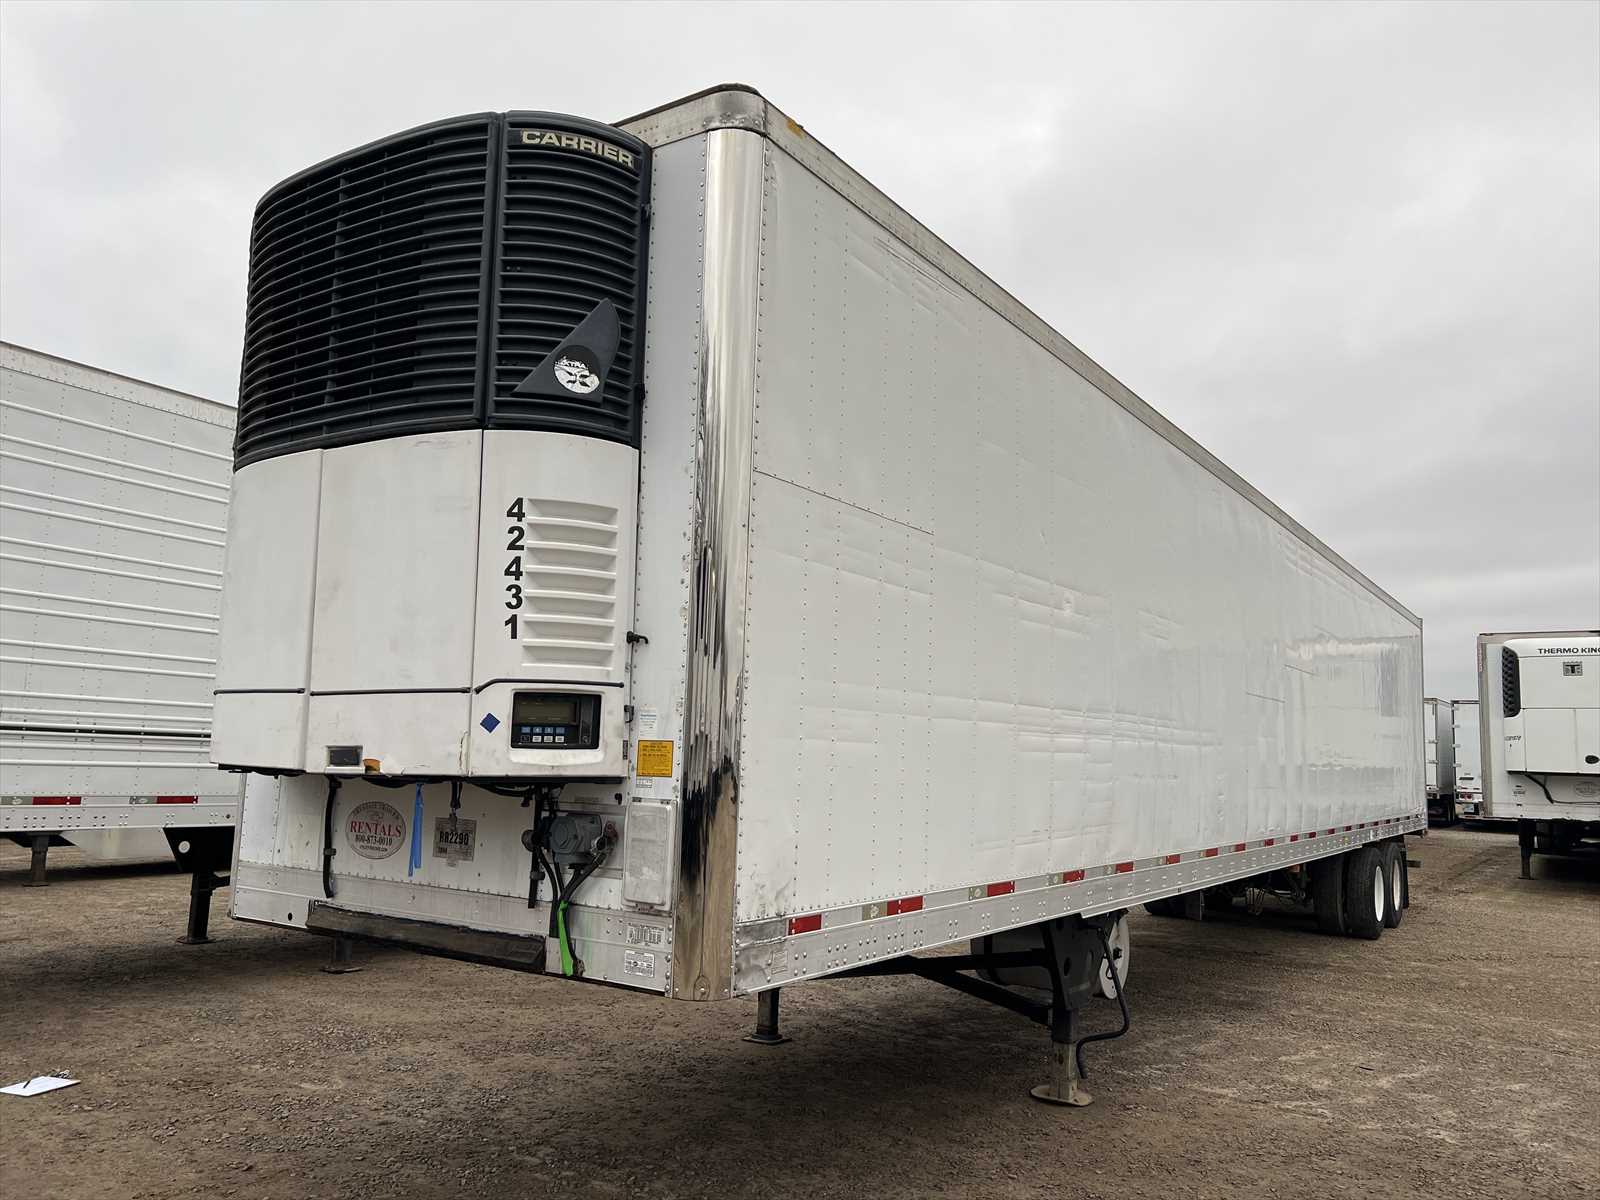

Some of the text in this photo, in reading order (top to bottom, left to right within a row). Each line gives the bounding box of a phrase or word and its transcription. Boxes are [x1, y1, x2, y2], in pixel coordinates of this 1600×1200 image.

[521, 130, 634, 168] CARRIER
[503, 497, 526, 640] 42431
[1537, 647, 1579, 655] THERMO
[350, 821, 402, 838] RENTALS
